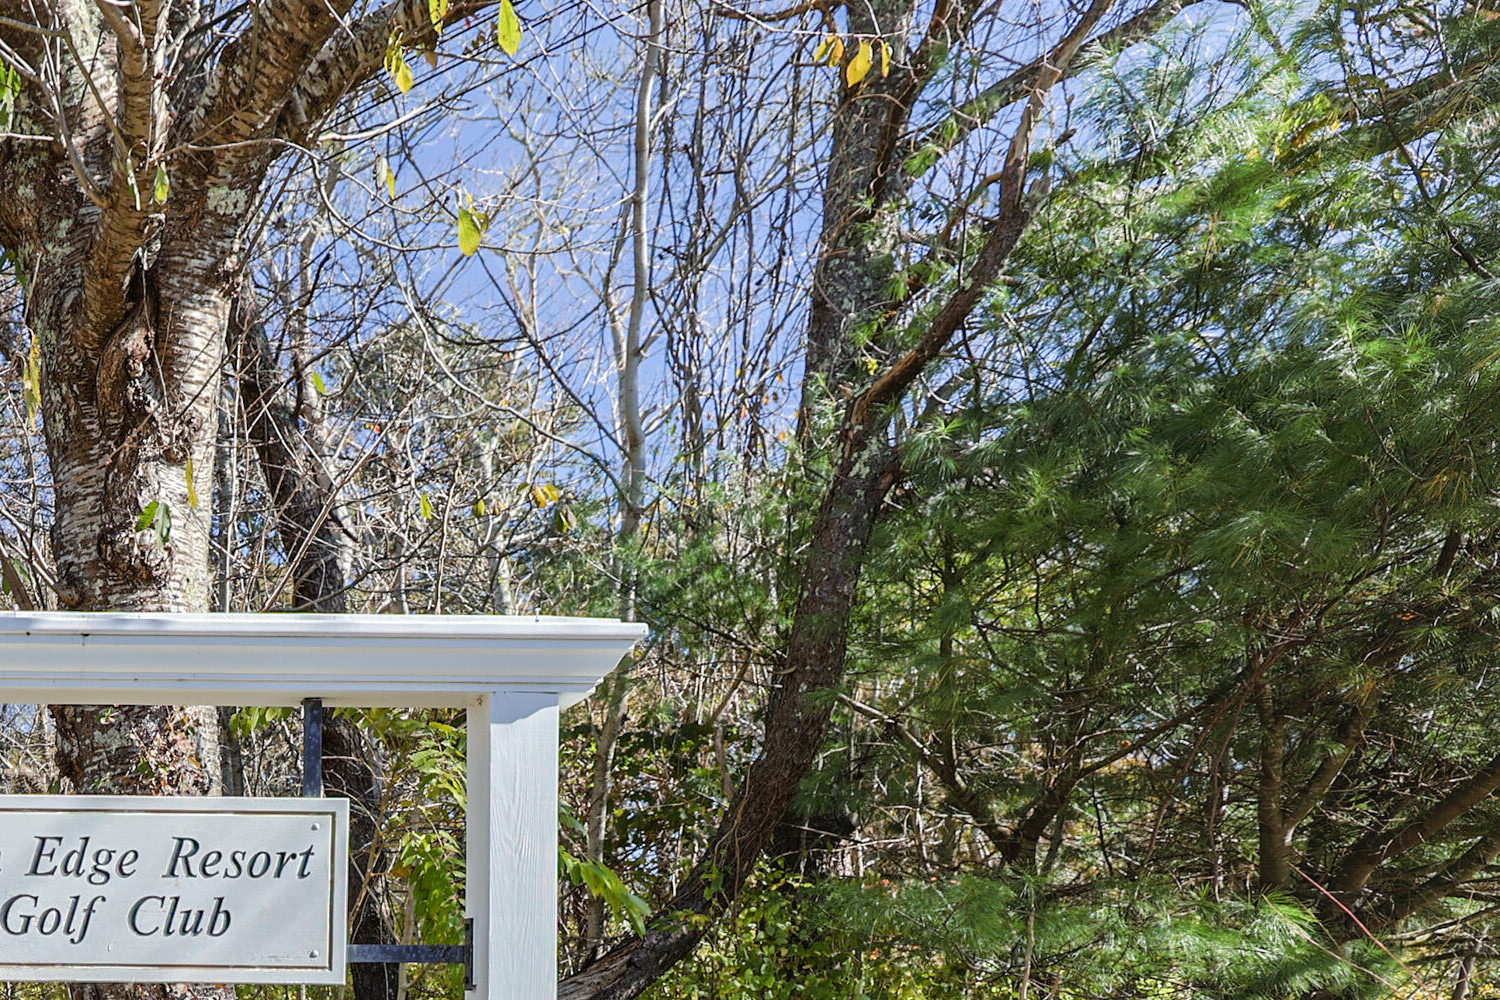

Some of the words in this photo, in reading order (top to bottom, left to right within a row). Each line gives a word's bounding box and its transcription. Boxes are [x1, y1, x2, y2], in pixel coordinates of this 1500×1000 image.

[25, 835, 139, 886] Edge
[162, 836, 315, 880] Resort
[0, 893, 107, 945] Golf
[128, 895, 232, 937] Club
